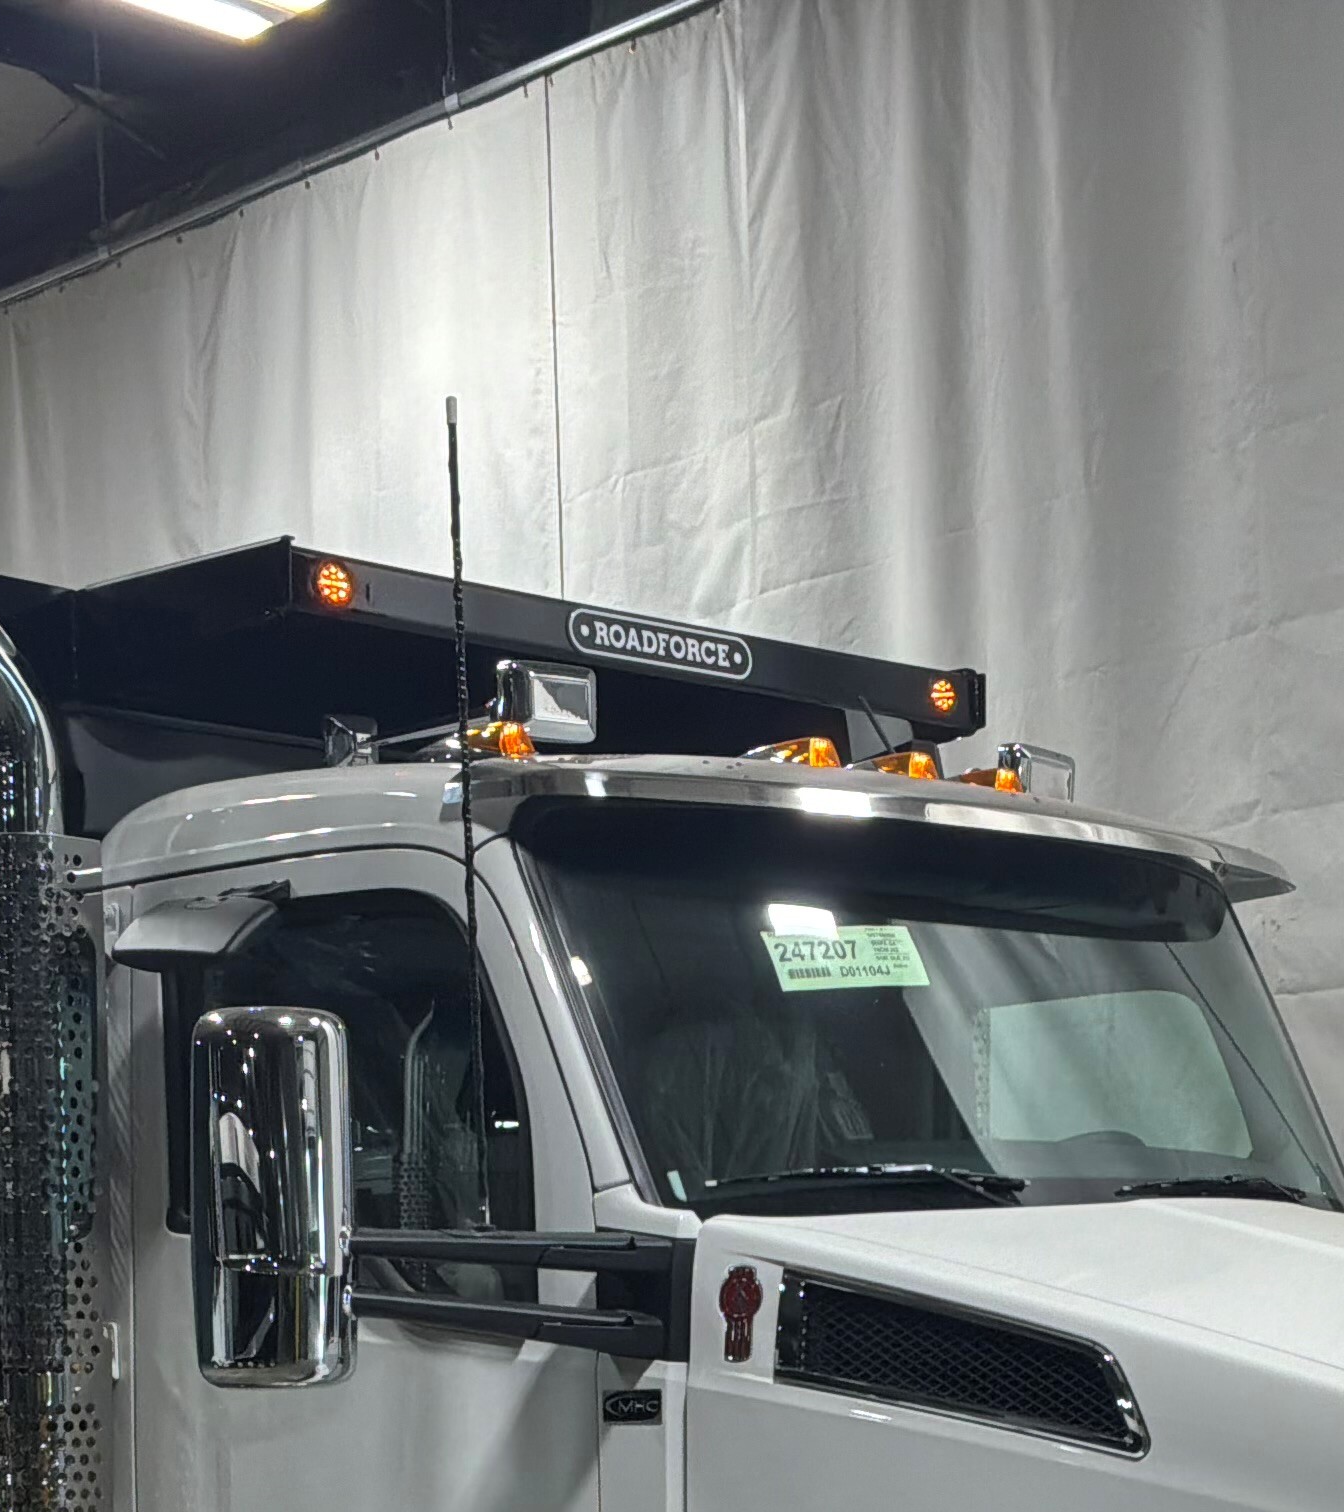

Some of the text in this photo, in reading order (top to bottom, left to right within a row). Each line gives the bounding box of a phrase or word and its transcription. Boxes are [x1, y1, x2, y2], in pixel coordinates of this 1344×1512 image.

[593, 620, 731, 668] ROADFORCE
[773, 939, 857, 963] 247207
[840, 964, 891, 978] D01104J
[618, 1400, 659, 1413] MHC
